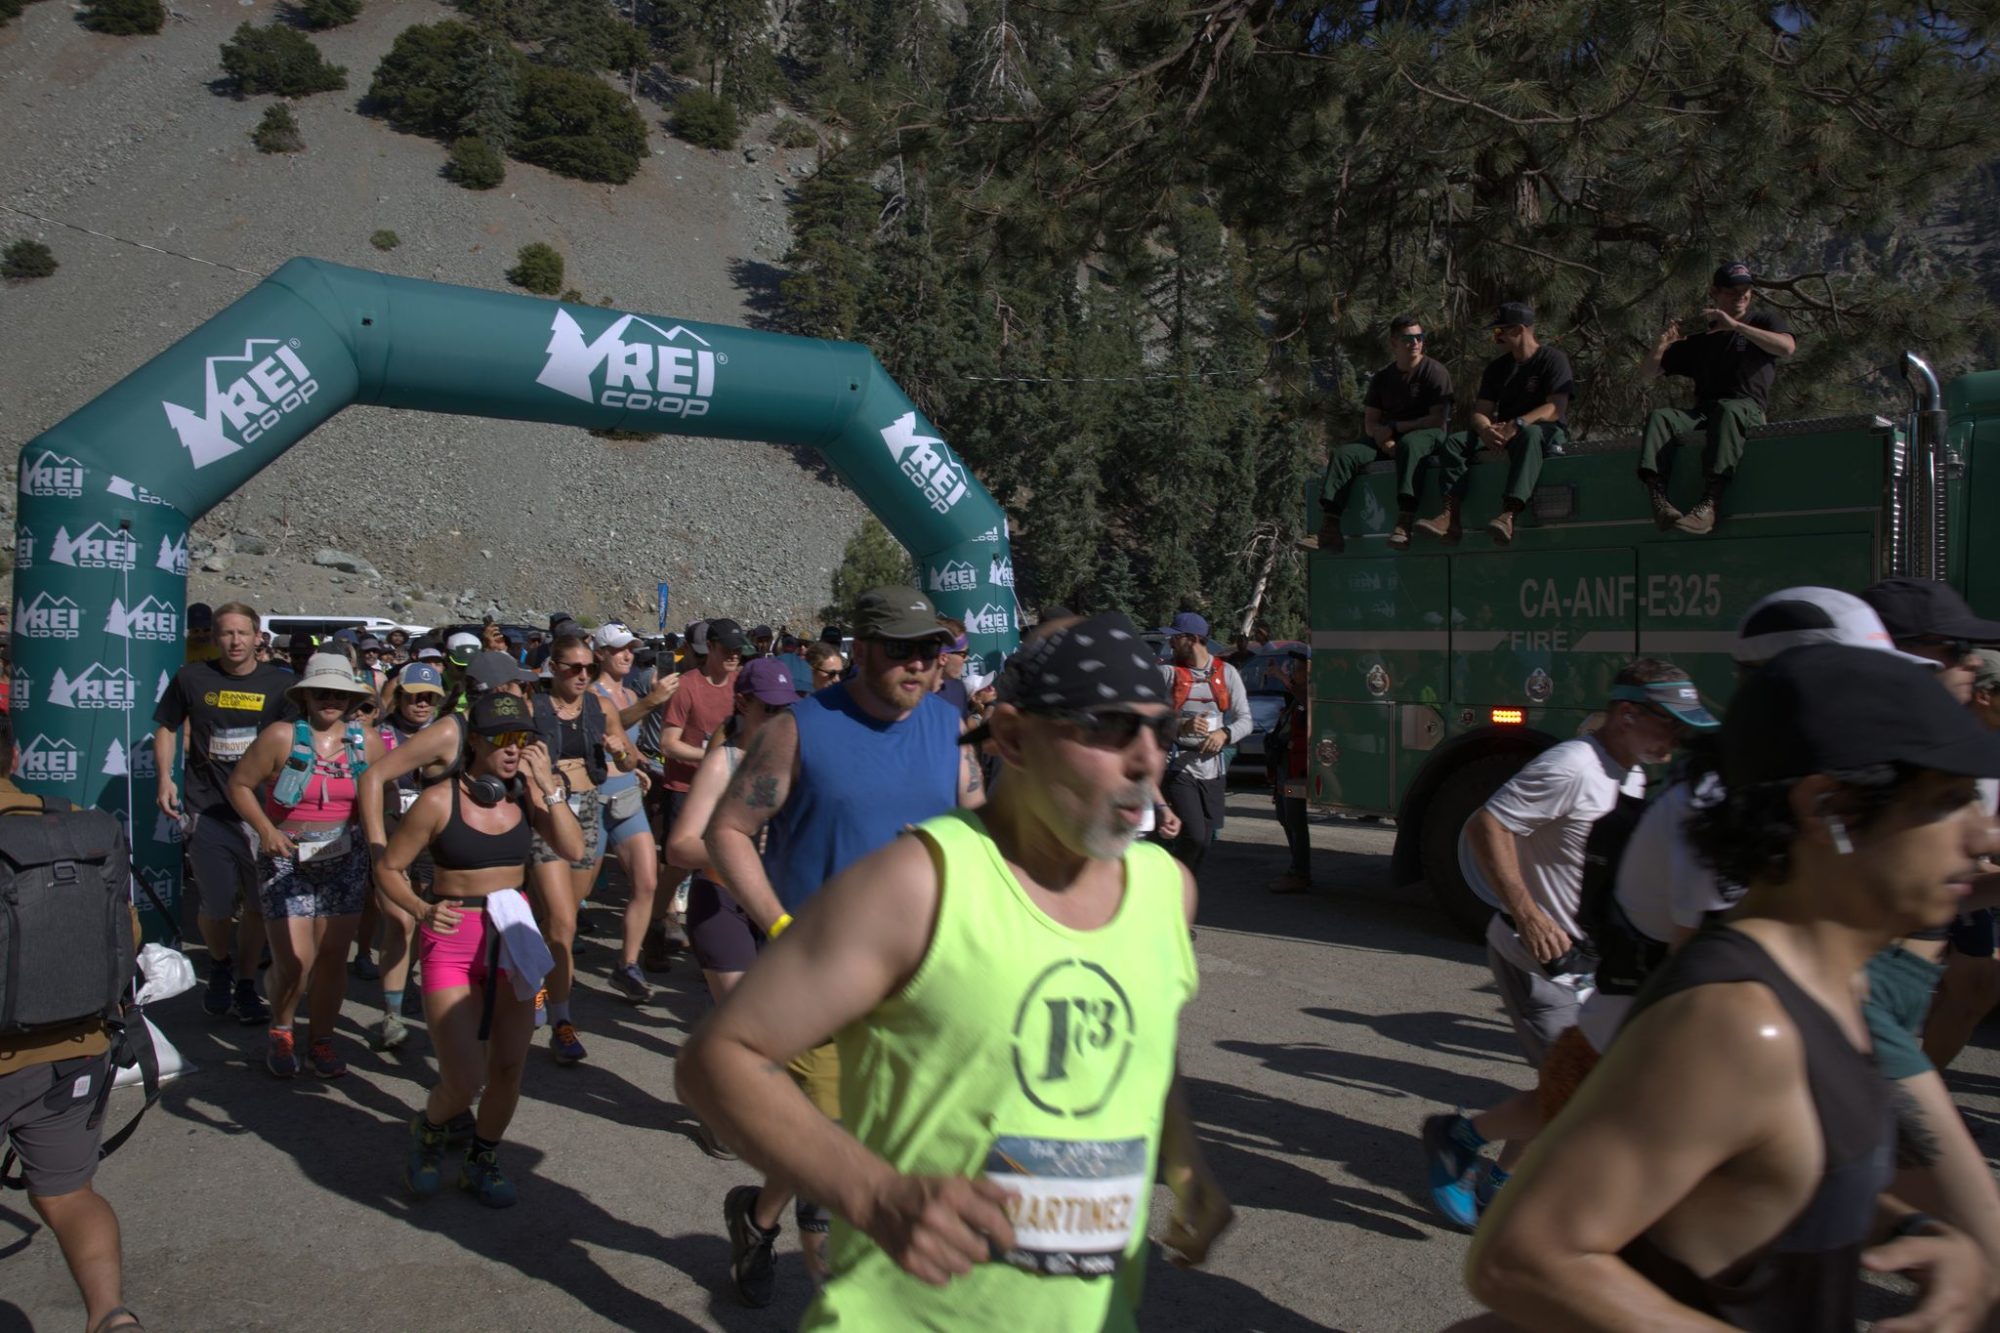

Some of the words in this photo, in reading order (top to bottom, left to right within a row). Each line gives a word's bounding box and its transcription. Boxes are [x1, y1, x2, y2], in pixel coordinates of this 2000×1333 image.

[605, 341, 715, 398] REI
[219, 344, 311, 432] REI
[35, 467, 83, 488] REI
[909, 445, 967, 506] REI
[16, 538, 33, 558] EI
[79, 539, 136, 561] REI
[944, 568, 977, 585] REI
[1519, 574, 1721, 618] CA-ANF-E325
[30, 608, 79, 629] REI
[135, 611, 176, 632] REI
[981, 613, 1008, 629] REI
[1510, 630, 1568, 651] FIRE
[78, 679, 135, 700] REI
[27, 751, 77, 771] REI
